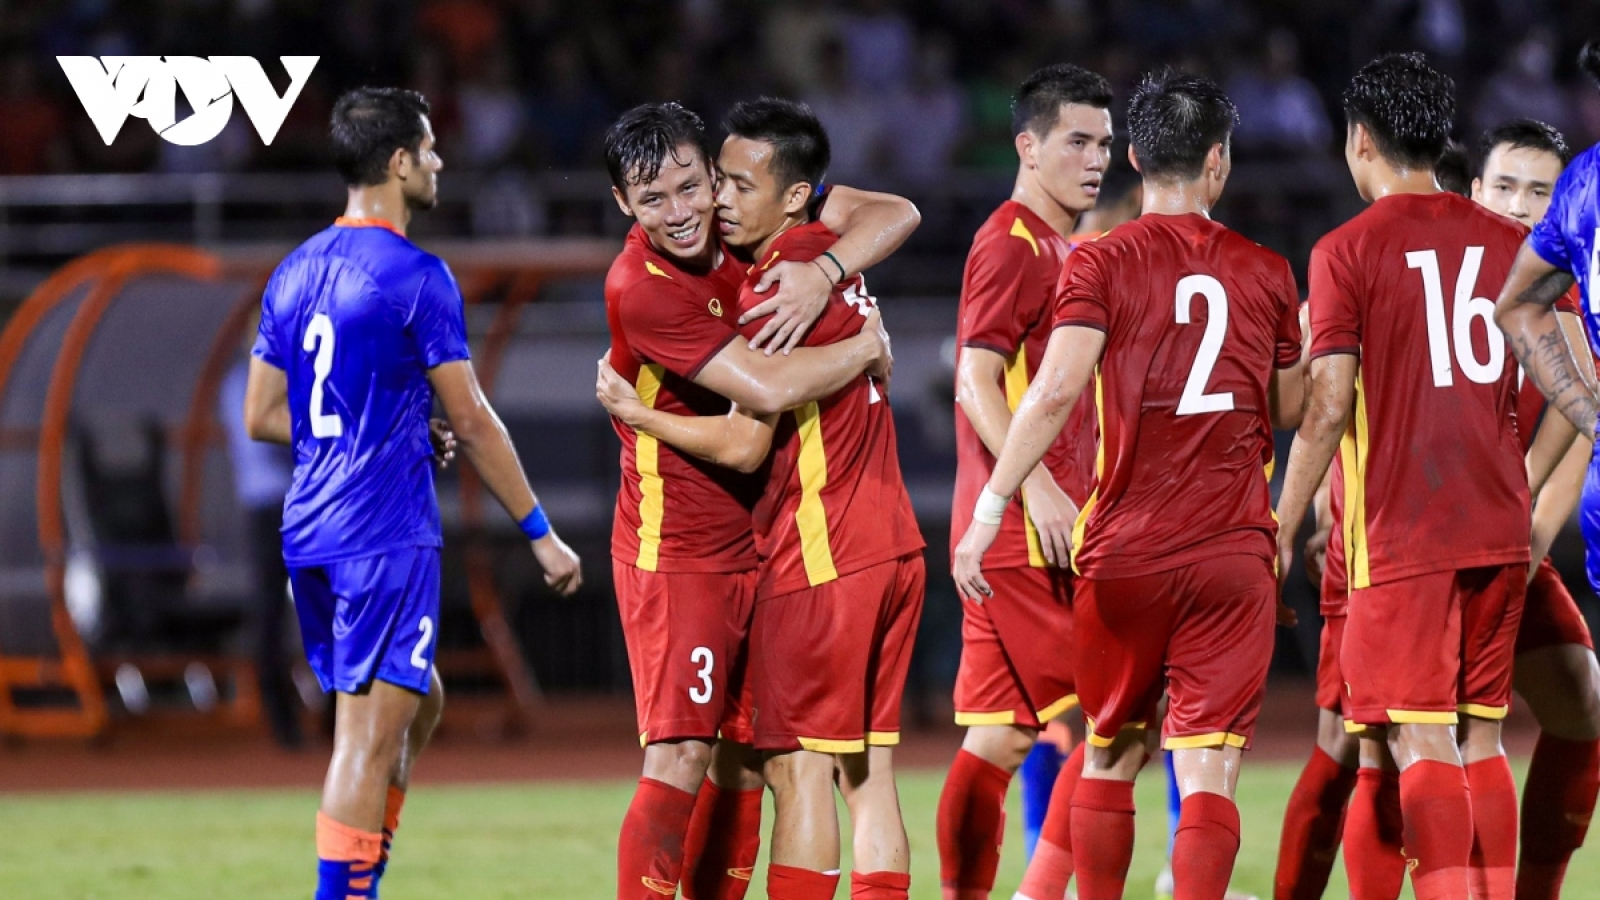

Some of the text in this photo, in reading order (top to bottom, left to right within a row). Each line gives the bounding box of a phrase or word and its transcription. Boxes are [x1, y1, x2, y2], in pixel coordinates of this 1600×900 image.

[303, 312, 341, 438] 2
[1175, 274, 1235, 415] 2
[1405, 246, 1506, 387] 16
[410, 615, 433, 671] 2
[688, 646, 714, 704] 3
